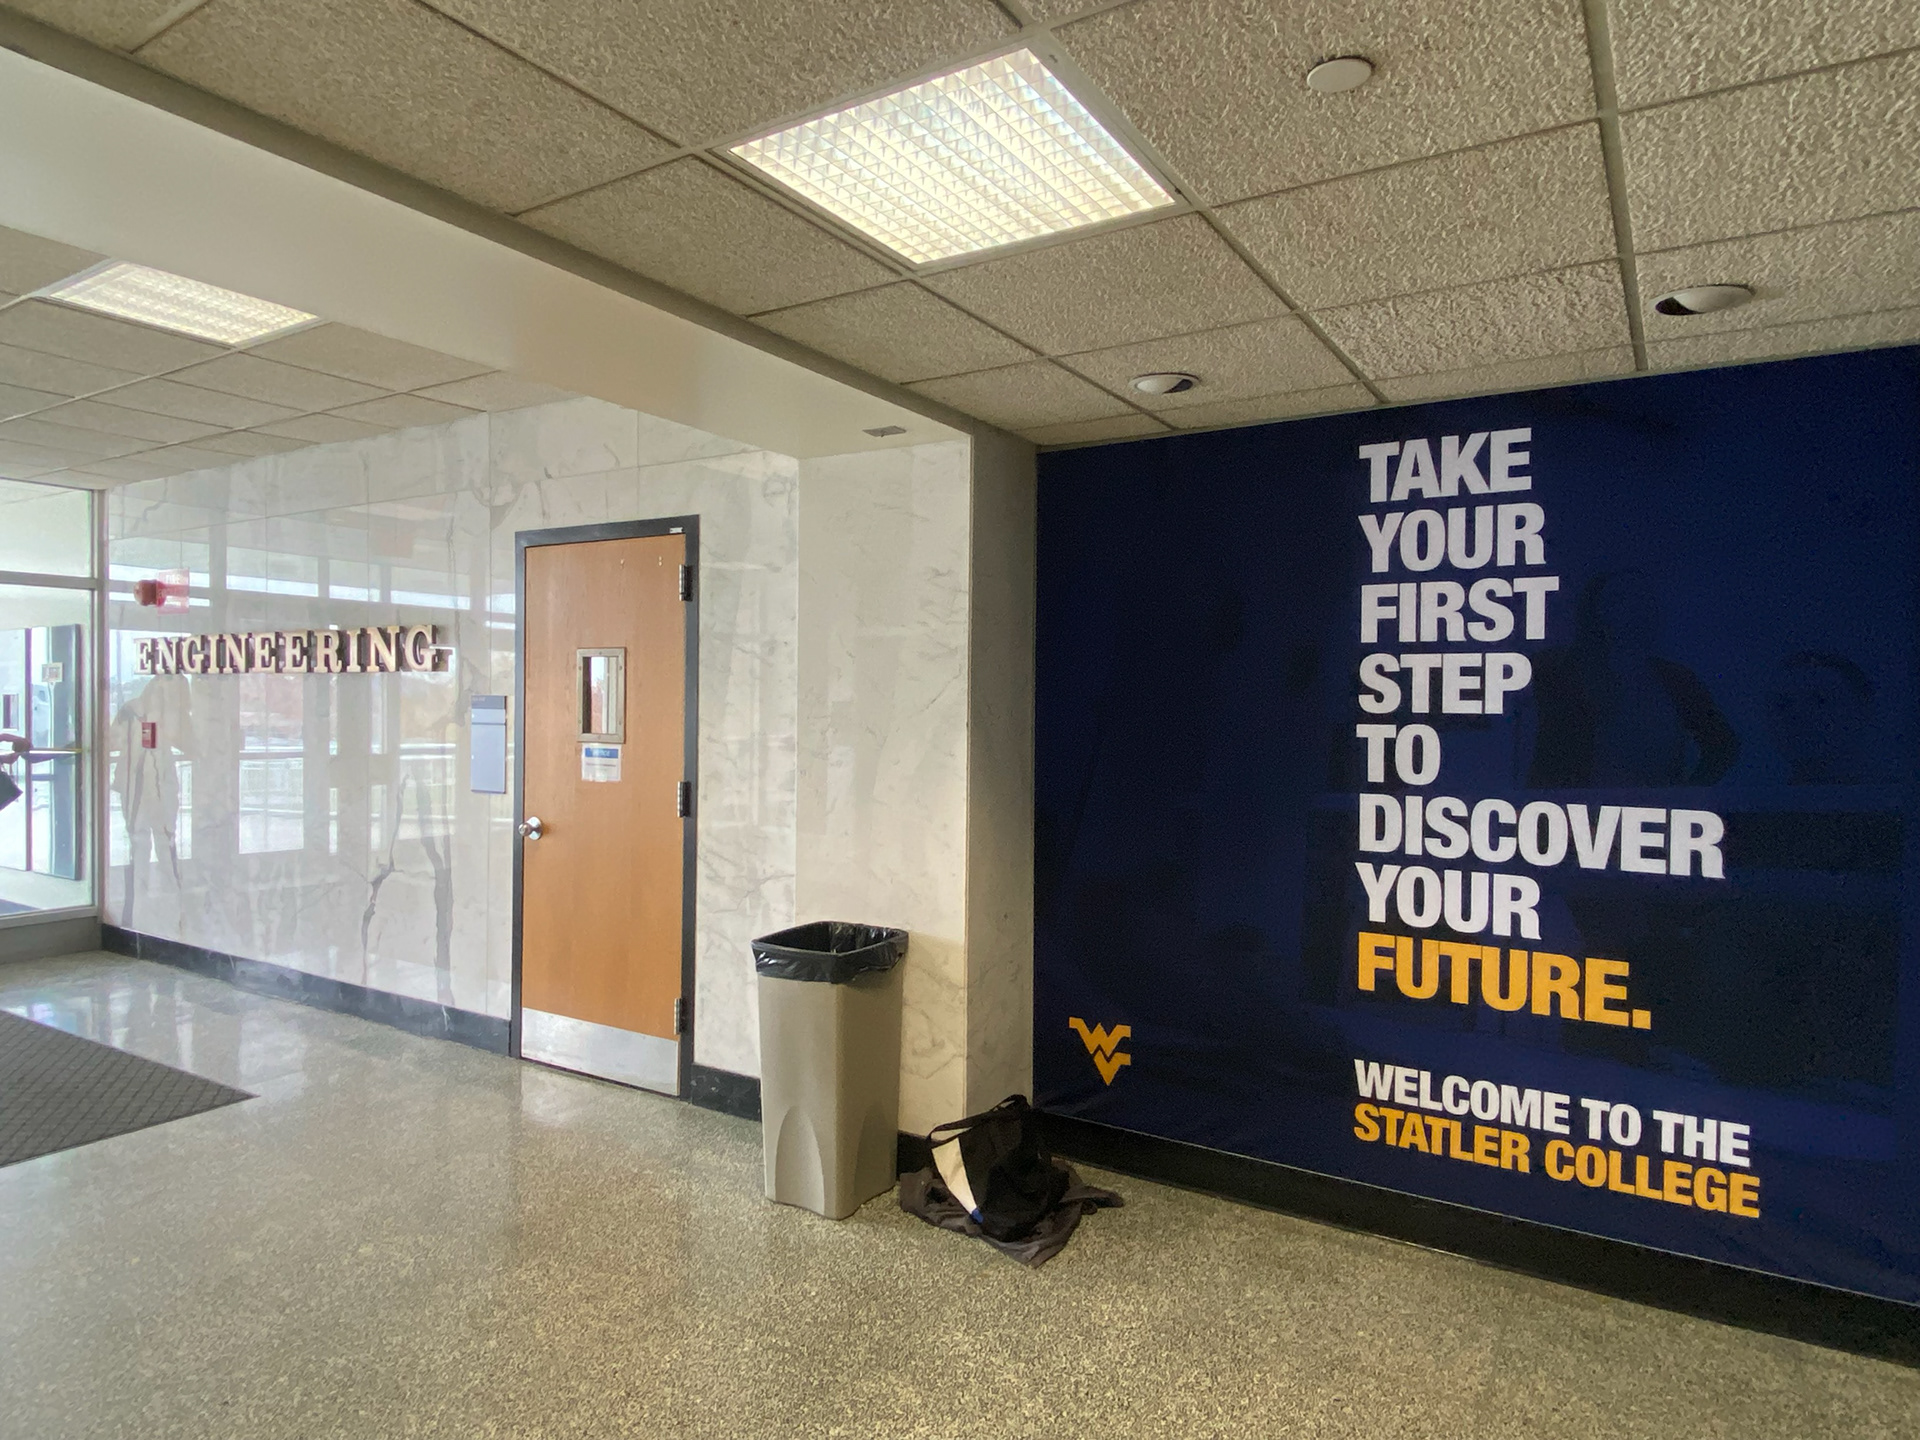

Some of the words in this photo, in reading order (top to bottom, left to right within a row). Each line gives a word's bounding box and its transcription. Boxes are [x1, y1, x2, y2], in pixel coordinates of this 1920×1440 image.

[1358, 427, 1532, 503] TAKE
[1357, 502, 1547, 573] YOUR
[1360, 575, 1560, 644] FIRST
[134, 625, 436, 674] ENGINEERING
[1358, 652, 1533, 715] STEP
[1355, 723, 1441, 786] TO
[1358, 793, 1726, 880] DISCOVER
[1354, 862, 1542, 941] YOUR
[1357, 931, 1652, 1030] FUTURE.
[1353, 1058, 1571, 1135] WELCOME
[1580, 1097, 1642, 1147] TO
[1652, 1109, 1751, 1168] THE
[1353, 1102, 1531, 1174] STATLER
[1544, 1139, 1761, 1219] COLLEGE
